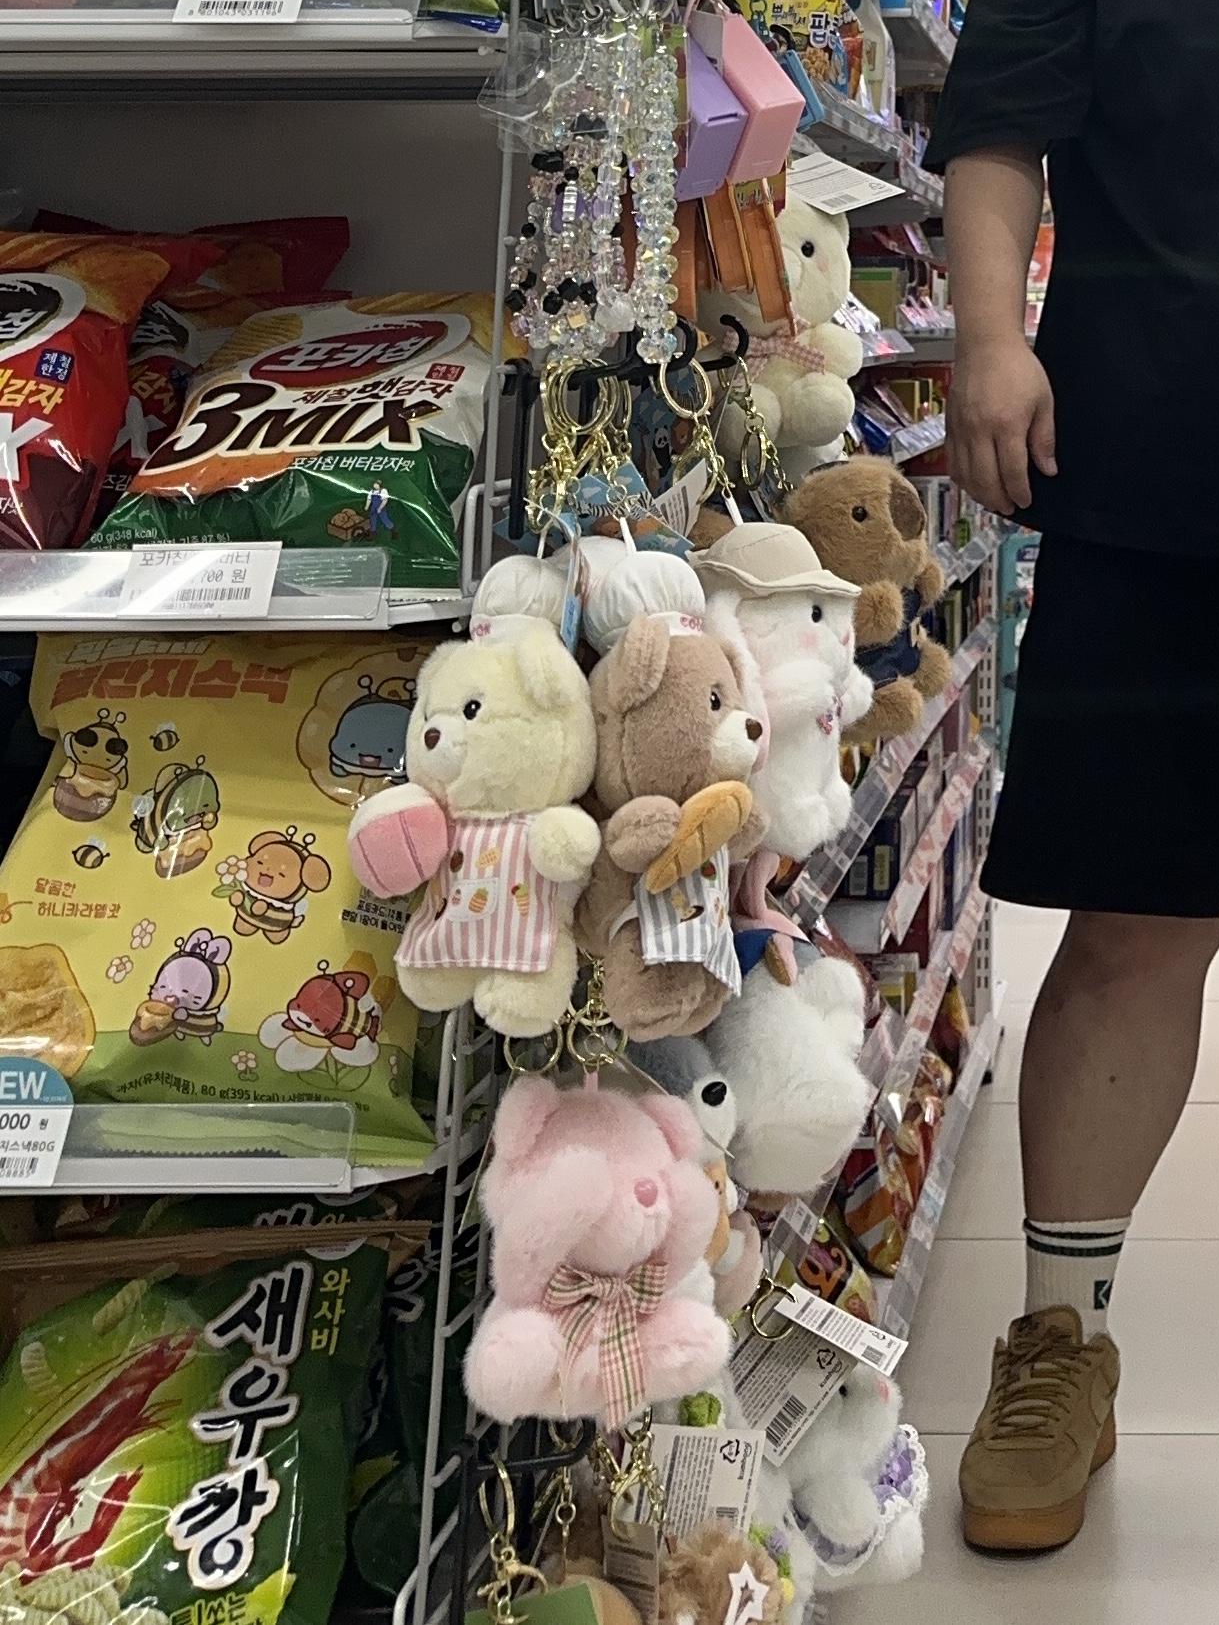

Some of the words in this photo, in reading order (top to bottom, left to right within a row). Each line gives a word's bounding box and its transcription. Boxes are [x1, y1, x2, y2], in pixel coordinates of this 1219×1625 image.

[261, 335, 434, 372] 포카칩
[0, 368, 65, 414] 감자
[291, 455, 339, 471] 포카칩
[339, 456, 415, 472] 버터감자맛
[134, 527, 157, 540] kcal)
[231, 568, 247, 584] 원
[35, 877, 77, 899] 달콤한
[37, 900, 122, 920] 허니카라멜맛
[201, 1085, 217, 1097] 80
[253, 1090, 280, 1103] kcal)
[310, 1267, 350, 1357] 와사비
[168, 1262, 314, 1589] 새우깡
